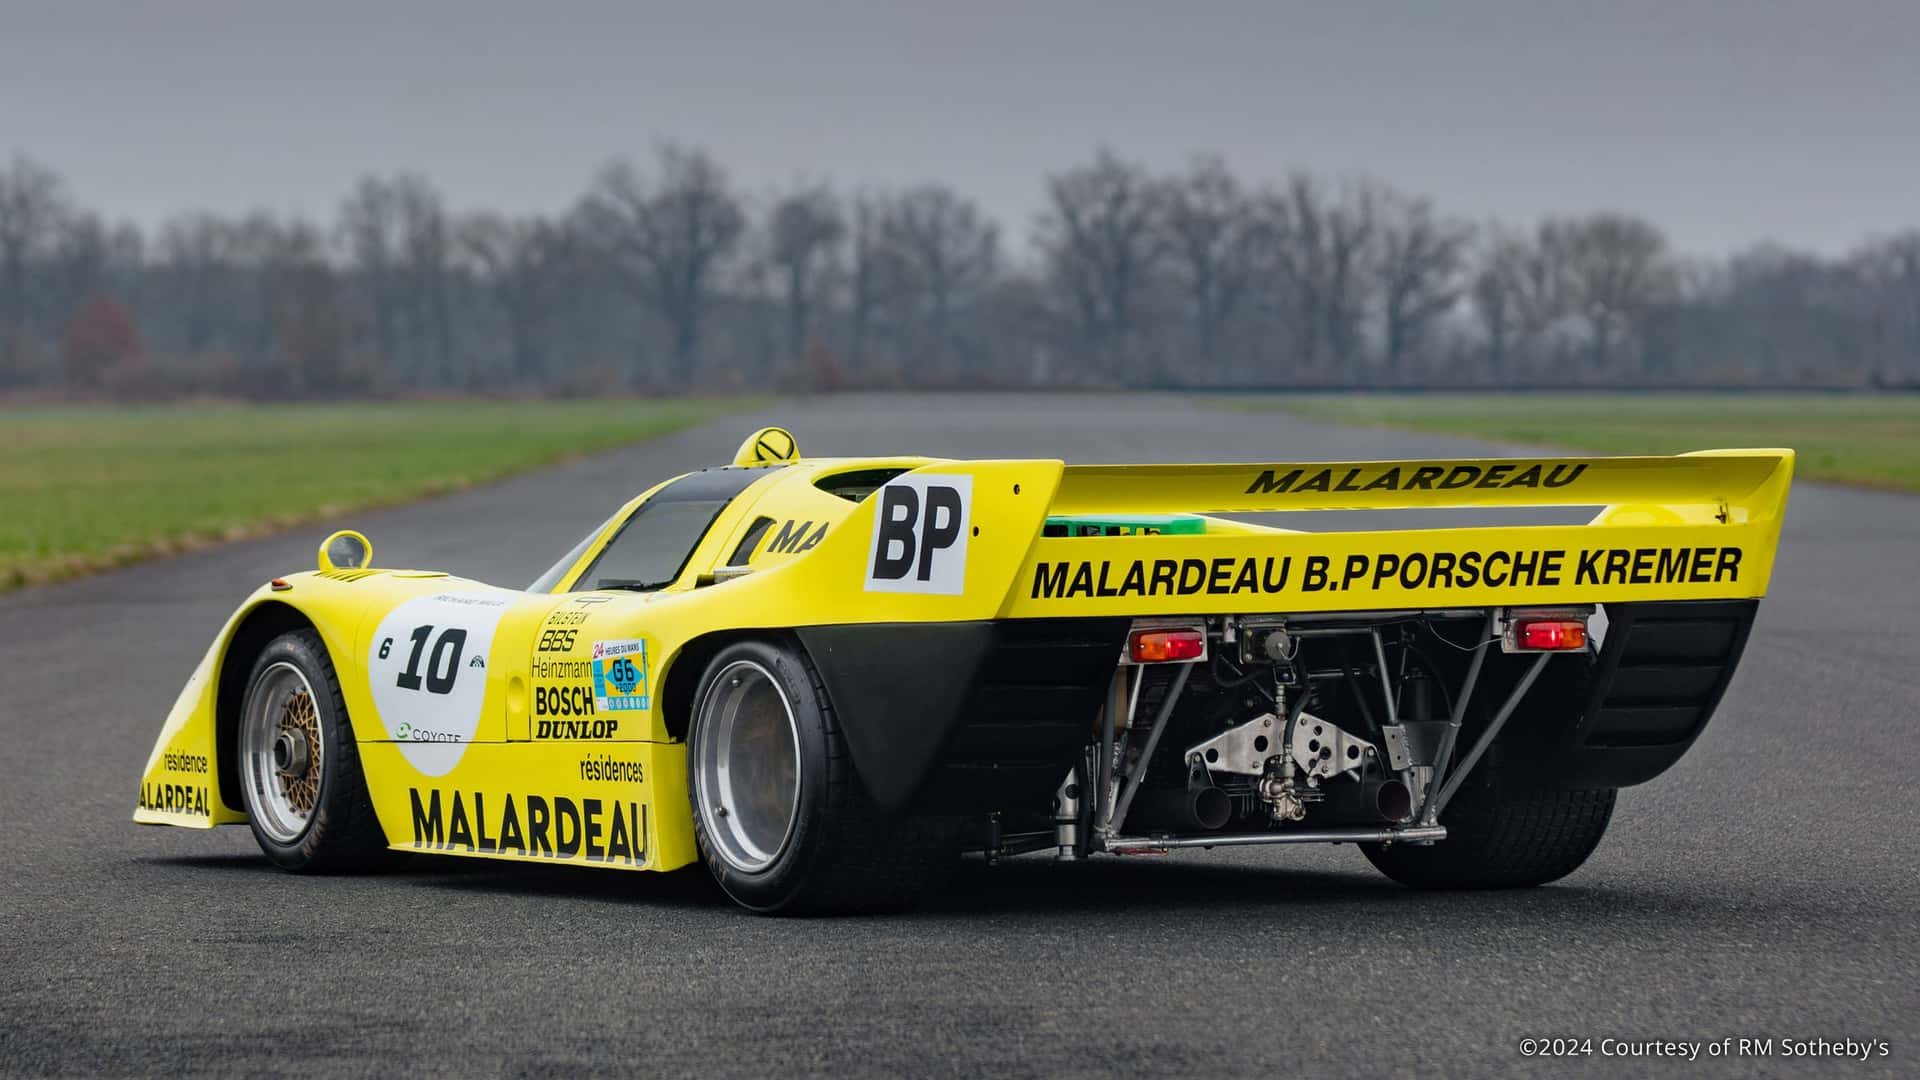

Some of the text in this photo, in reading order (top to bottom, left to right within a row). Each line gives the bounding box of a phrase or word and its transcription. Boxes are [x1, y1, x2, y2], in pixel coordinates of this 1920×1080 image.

[1244, 463, 1589, 495] MALARDEAU
[871, 484, 962, 581] BP
[1031, 556, 1291, 599] MALARDEAU
[1574, 546, 1742, 586] KREMER
[378, 637, 394, 660] 6
[538, 629, 578, 651] BBS
[396, 624, 468, 695] 10
[532, 657, 592, 678] Heinzmann
[613, 659, 634, 682] G6
[536, 686, 595, 716] BOSCH
[413, 728, 462, 743] COYOTE
[536, 720, 618, 739] DUNLOP
[580, 753, 643, 783] résidences
[409, 787, 648, 866] MALARDEAU
